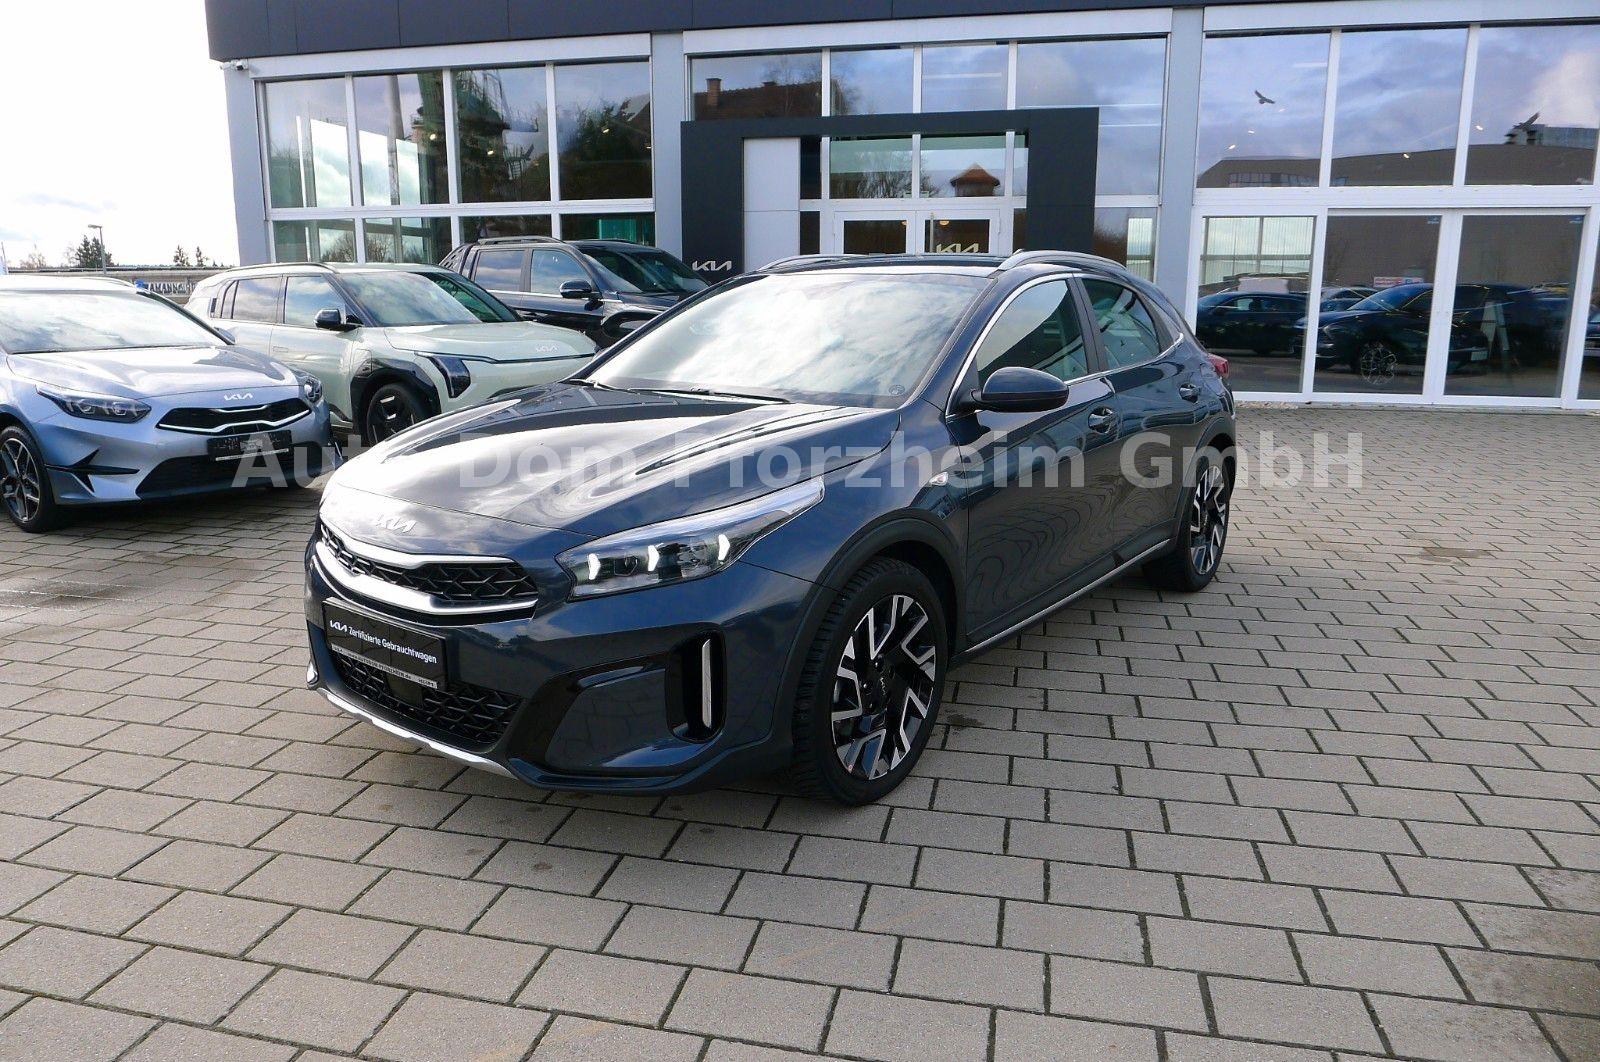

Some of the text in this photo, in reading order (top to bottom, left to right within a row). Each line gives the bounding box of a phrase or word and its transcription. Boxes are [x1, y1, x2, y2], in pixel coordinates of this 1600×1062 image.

[936, 243, 979, 253] KIA
[692, 260, 732, 271] KIA
[223, 392, 253, 401] KIA
[375, 513, 418, 533] KIA
[329, 619, 348, 633] KIA
[349, 626, 382, 647] Zertifizierte
[381, 638, 438, 664] Gebrauchtwagen
